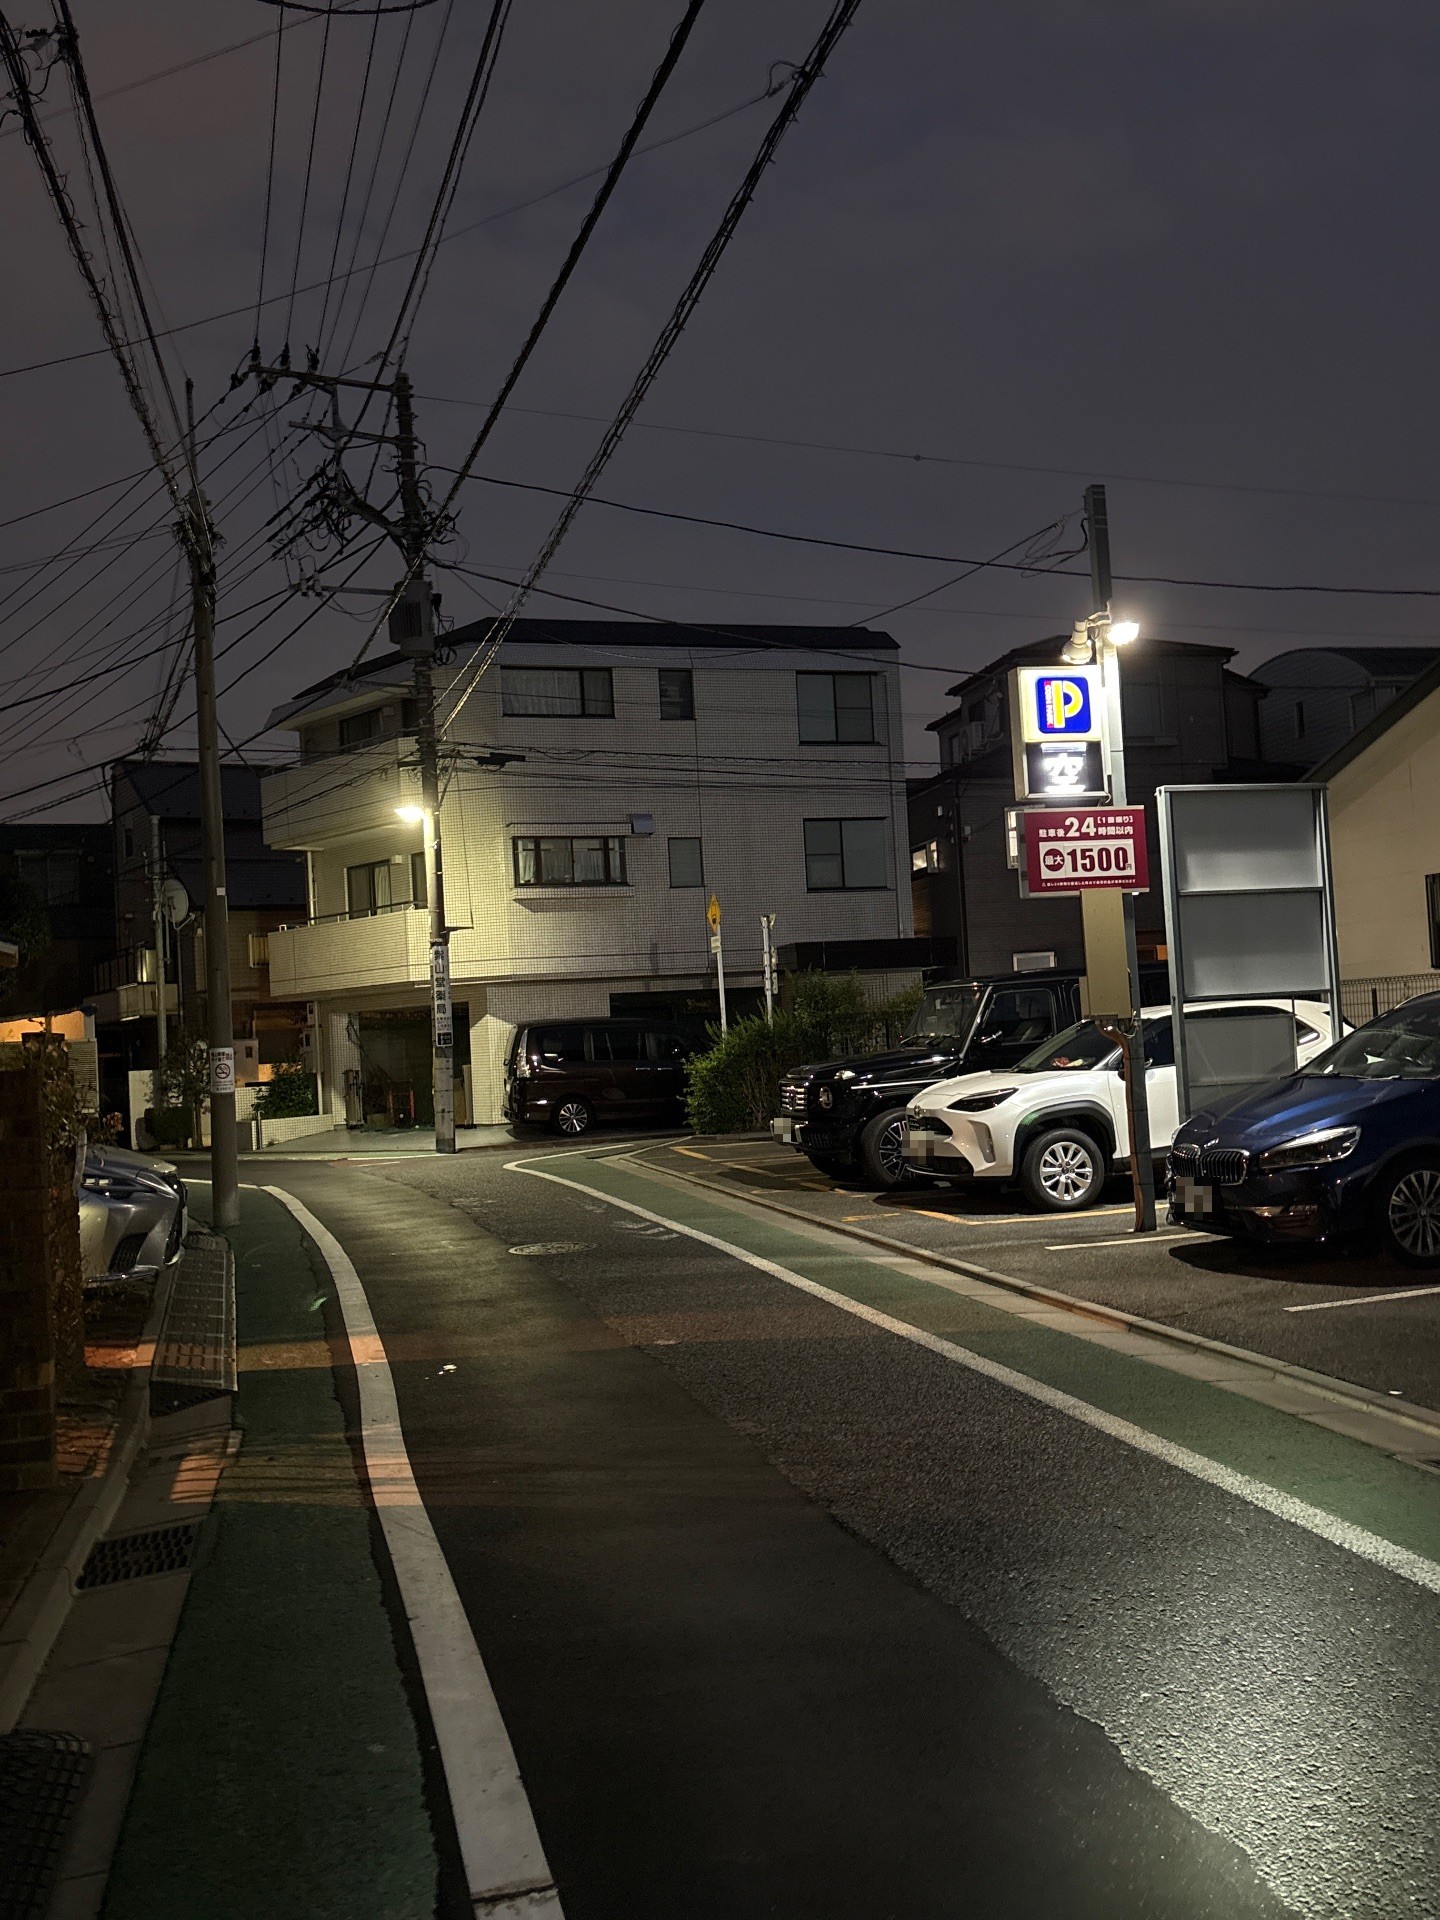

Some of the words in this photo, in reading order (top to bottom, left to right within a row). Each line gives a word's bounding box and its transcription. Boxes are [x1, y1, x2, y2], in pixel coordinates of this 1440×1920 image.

[1051, 680, 1083, 728] P
[1044, 753, 1086, 794] 空
[1045, 855, 1064, 866] 最大
